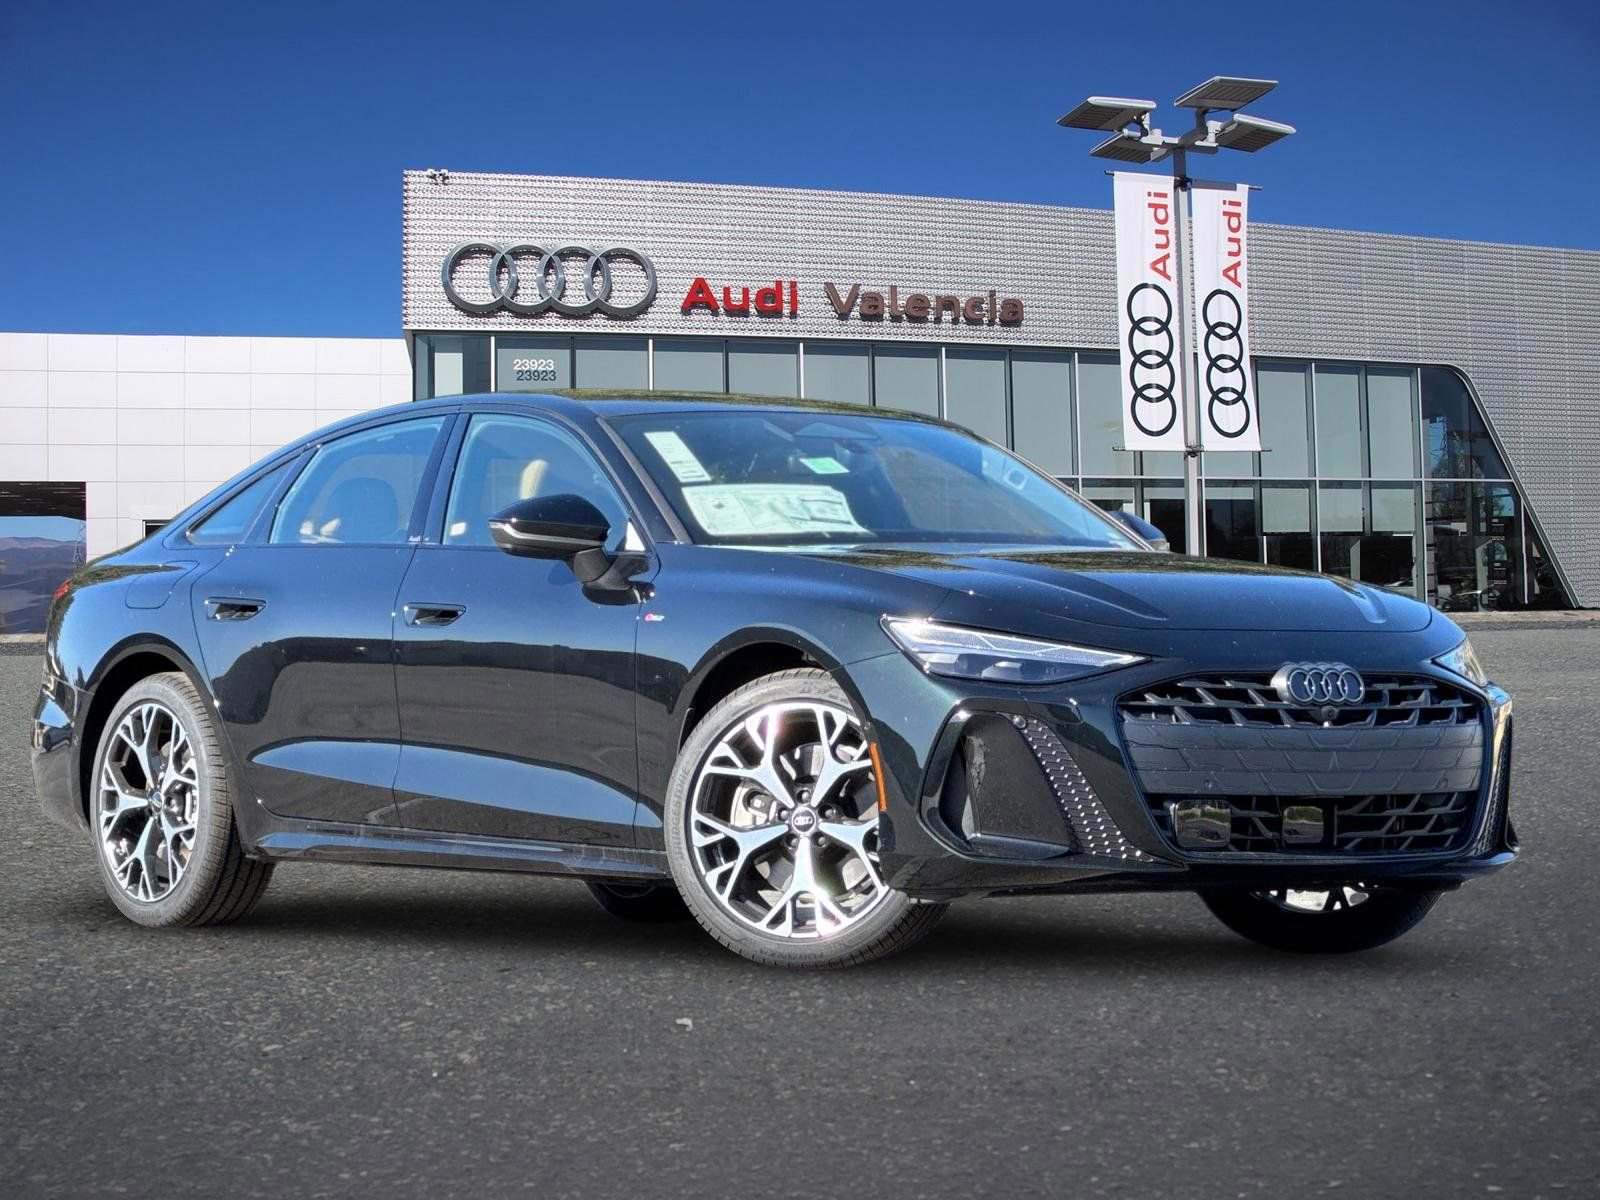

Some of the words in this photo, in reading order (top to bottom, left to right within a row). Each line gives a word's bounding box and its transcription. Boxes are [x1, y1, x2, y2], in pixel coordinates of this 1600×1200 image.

[1147, 191, 1171, 282] Audi
[1222, 199, 1242, 289] Audi
[681, 276, 798, 316] Audi
[824, 282, 1025, 325] Valencia
[513, 358, 554, 370] 23923
[516, 369, 557, 381] 23923
